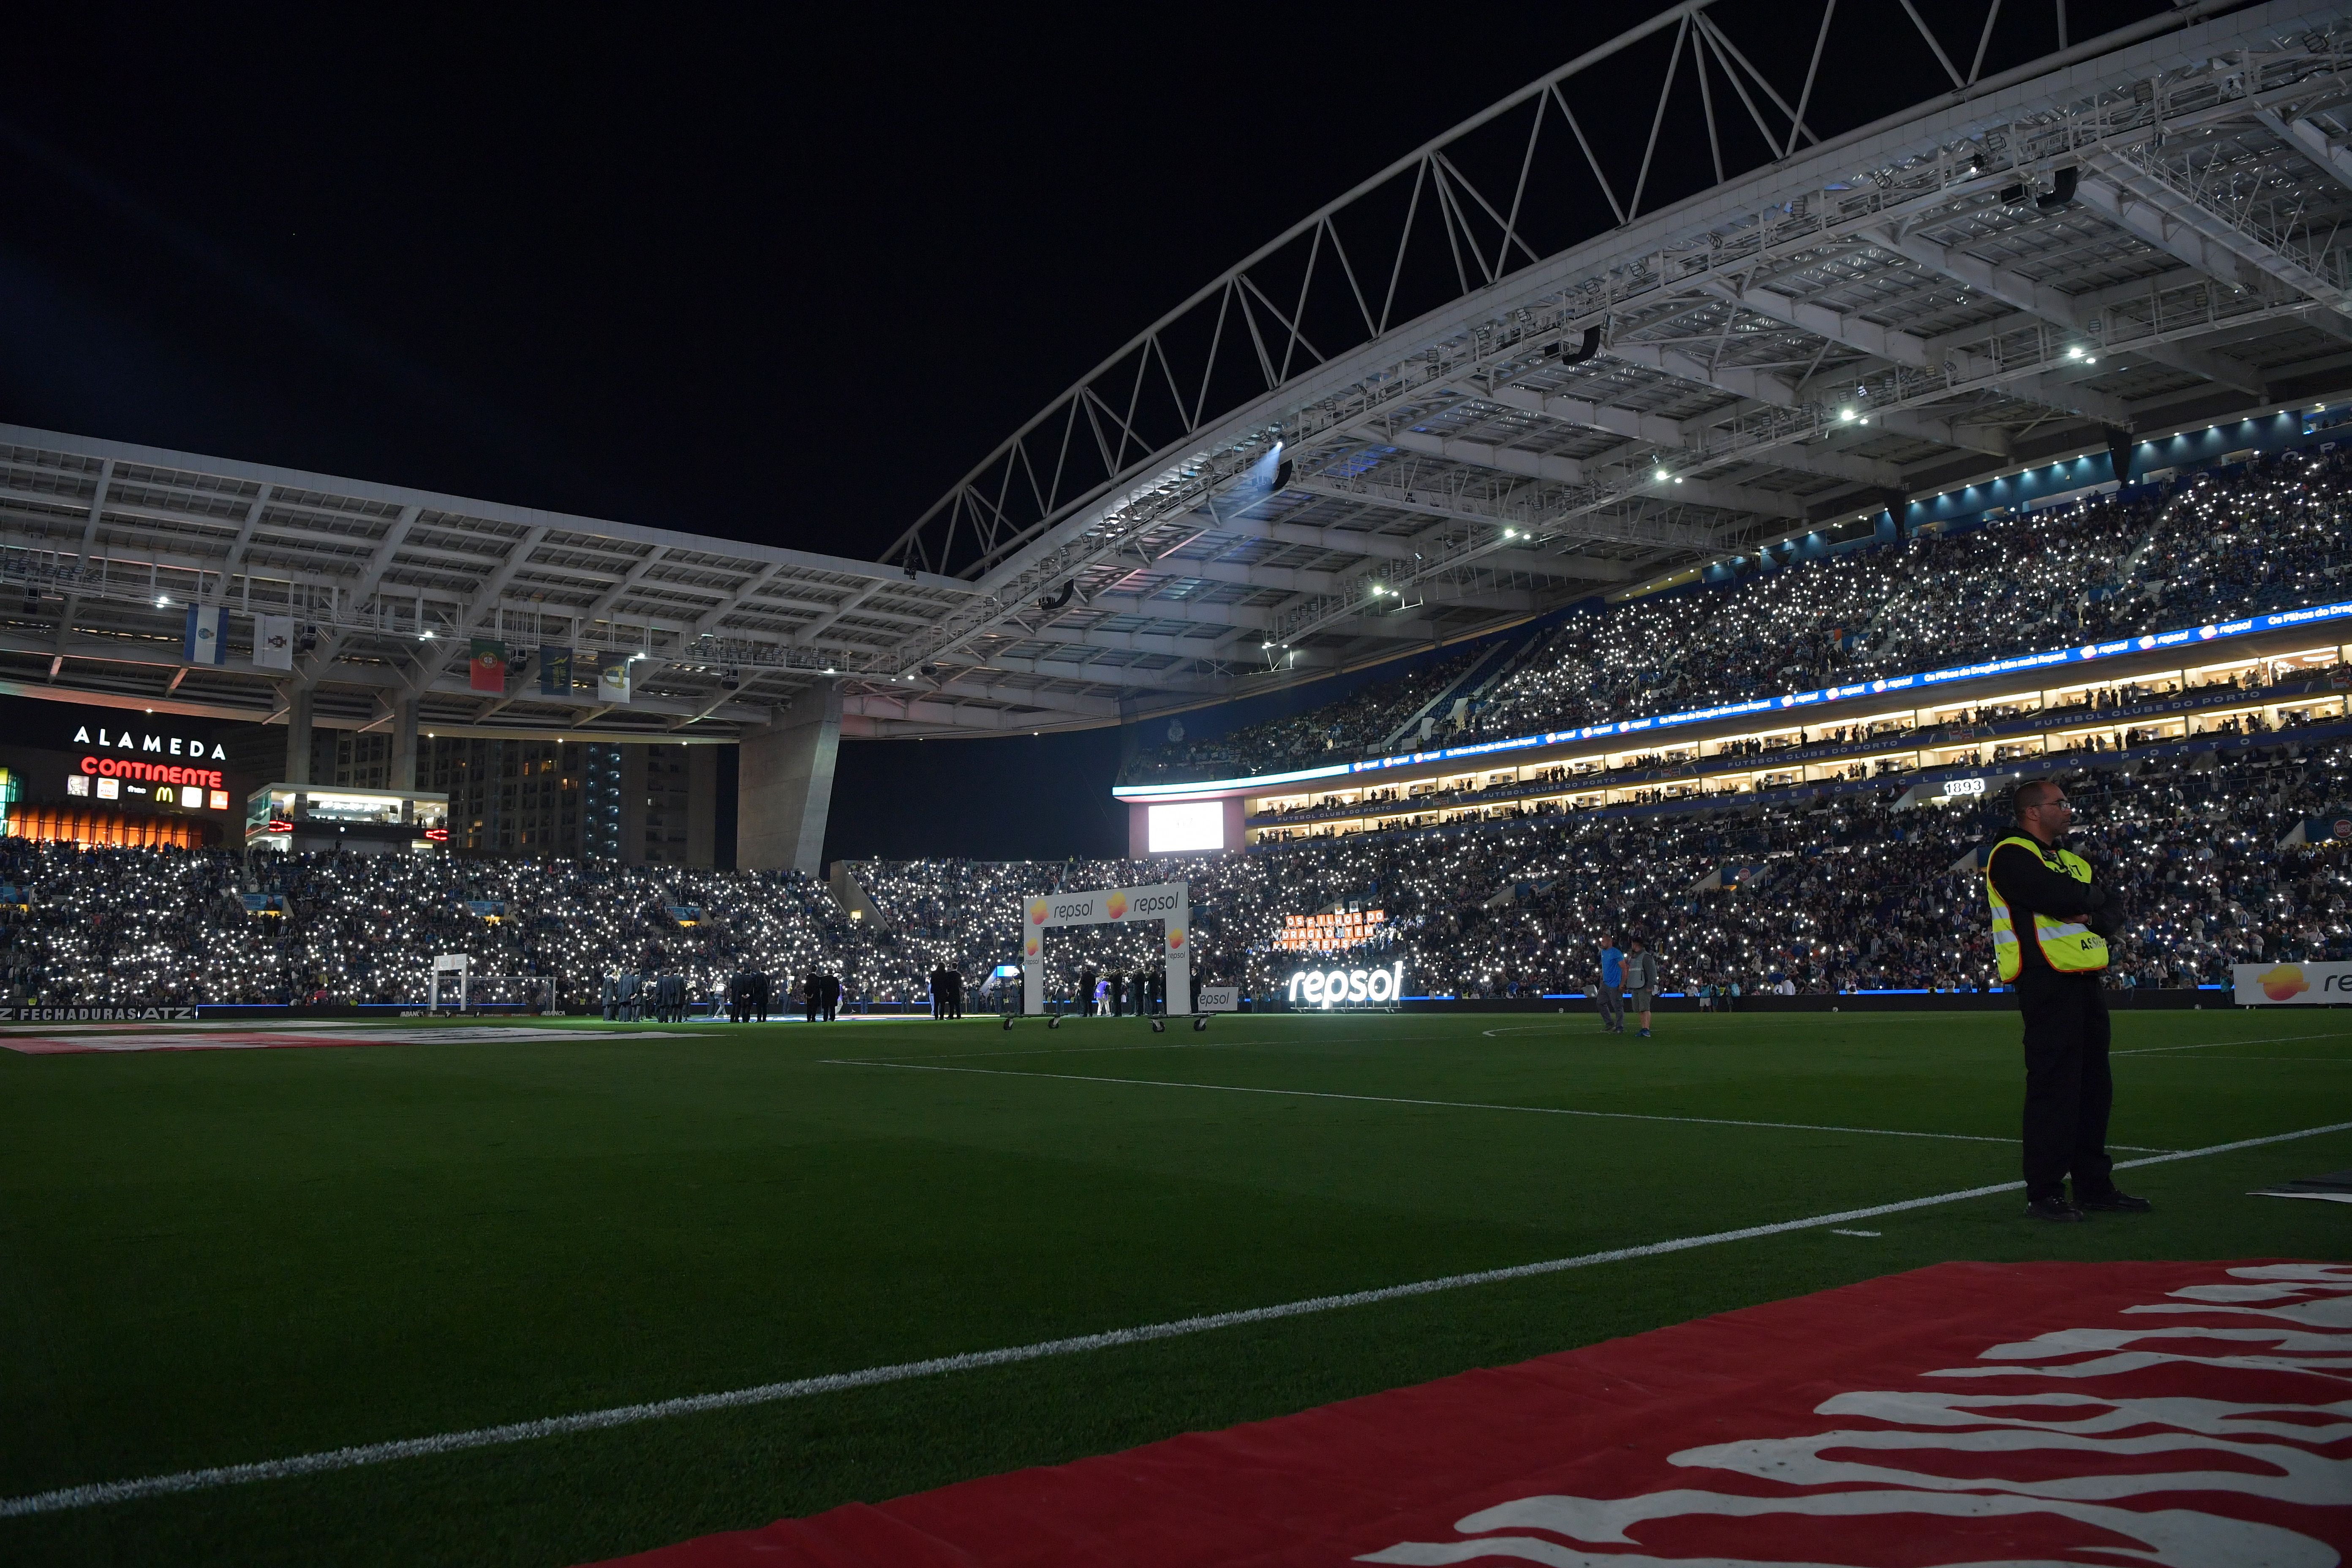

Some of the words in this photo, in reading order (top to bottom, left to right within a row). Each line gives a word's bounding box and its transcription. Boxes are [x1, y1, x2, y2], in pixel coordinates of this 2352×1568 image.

[2284, 612, 2314, 622] Filhos
[2315, 608, 2329, 617] do
[2099, 641, 2128, 653] repsol
[2158, 631, 2188, 644] repsol
[2219, 620, 2251, 633] repsol
[2035, 713, 2104, 727] FUTEBOL
[2112, 703, 2164, 716] CLUBE
[2172, 700, 2194, 708] DO
[2202, 690, 2260, 703] PORTO
[74, 726, 226, 760] ALAMEDA
[1728, 755, 1780, 767] FUTEBOL
[1786, 749, 1825, 759] CLUBE
[1832, 745, 1848, 753] DO
[1854, 739, 1897, 750] PORTO
[1483, 789, 1524, 798] FUTEBOL
[1530, 784, 1560, 792] CLUBE
[1583, 777, 1617, 786] PORTO
[1945, 779, 1982, 793] 1893
[1054, 900, 1093, 921] repsol
[1134, 892, 1179, 915] repsol
[1287, 917, 1302, 926] OS
[1308, 914, 1360, 927] FILHOS
[1368, 912, 1383, 921] DO
[1282, 929, 1333, 939] DRAGÃO
[1346, 926, 1373, 936] TÊM
[1168, 951, 1186, 960] repsol
[1289, 960, 1403, 1009] repsol
[1199, 992, 1230, 1007] epsol
[20, 1007, 137, 1019] FECHADURAS
[141, 1006, 192, 1018] ATZ
